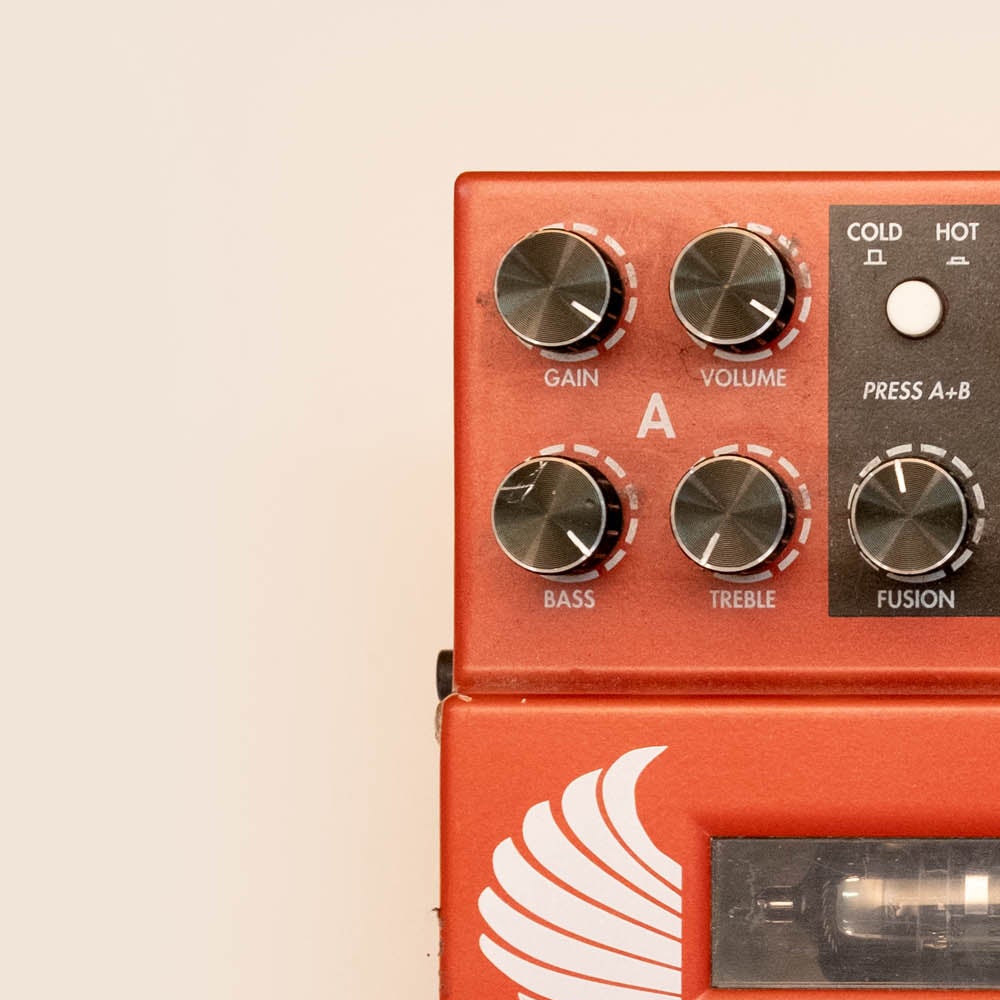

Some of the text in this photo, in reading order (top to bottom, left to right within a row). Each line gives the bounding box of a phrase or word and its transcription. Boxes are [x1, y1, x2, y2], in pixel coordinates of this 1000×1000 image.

[847, 222, 902, 242] COLD
[935, 222, 979, 241] HOT
[544, 368, 599, 387] GAIN
[701, 368, 787, 387] VOLUME
[863, 381, 971, 400] PRESS A+B
[636, 392, 677, 439] A
[543, 589, 596, 609] BASS
[709, 589, 776, 609] TREBLE
[877, 589, 955, 609] FUSION
